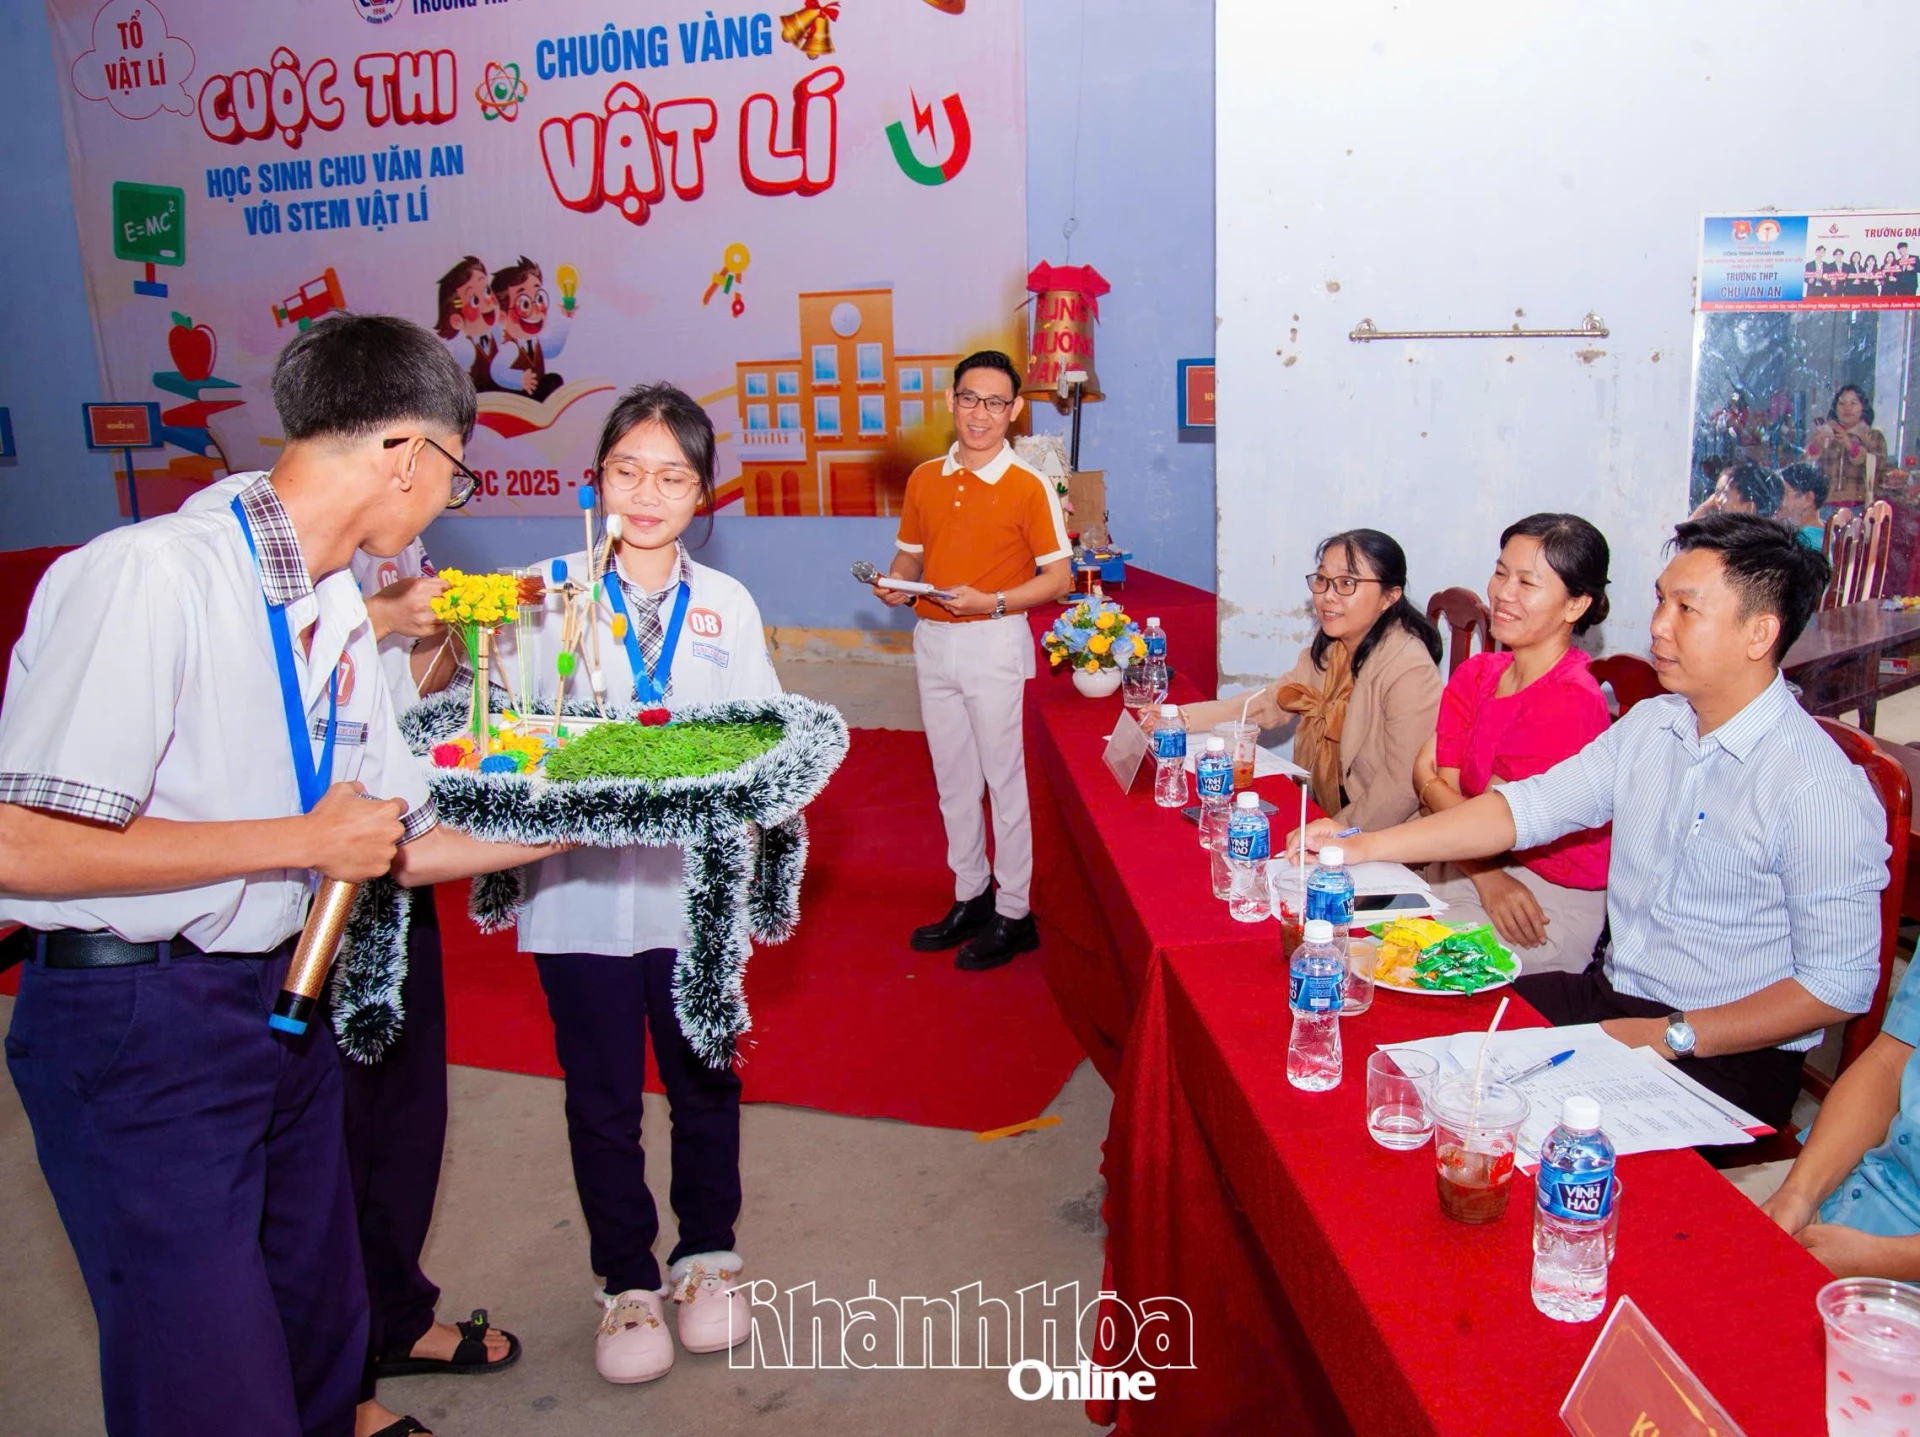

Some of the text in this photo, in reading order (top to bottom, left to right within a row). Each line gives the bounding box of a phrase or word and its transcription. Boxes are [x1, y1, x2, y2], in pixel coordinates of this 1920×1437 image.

[117, 10, 143, 49] TỔ
[535, 11, 773, 81] CHUÔNG VÀNG
[105, 52, 167, 95] VẬT LÍ
[199, 46, 457, 149] CUỘC THI
[539, 65, 845, 226] VẬT LÍ
[206, 144, 464, 202] HỌC SINH CHU VĂN AN
[244, 185, 428, 236] VỚI STEM VẬT LÍ
[1864, 227, 1903, 238] TRƯỜNG
[1721, 286, 1740, 297] CHU
[1767, 286, 1782, 297] AN
[1726, 271, 1778, 281] TRƯỜNG THPT
[472, 469, 498, 502] ỌC
[506, 470, 560, 497] 2025
[691, 613, 719, 634] 08
